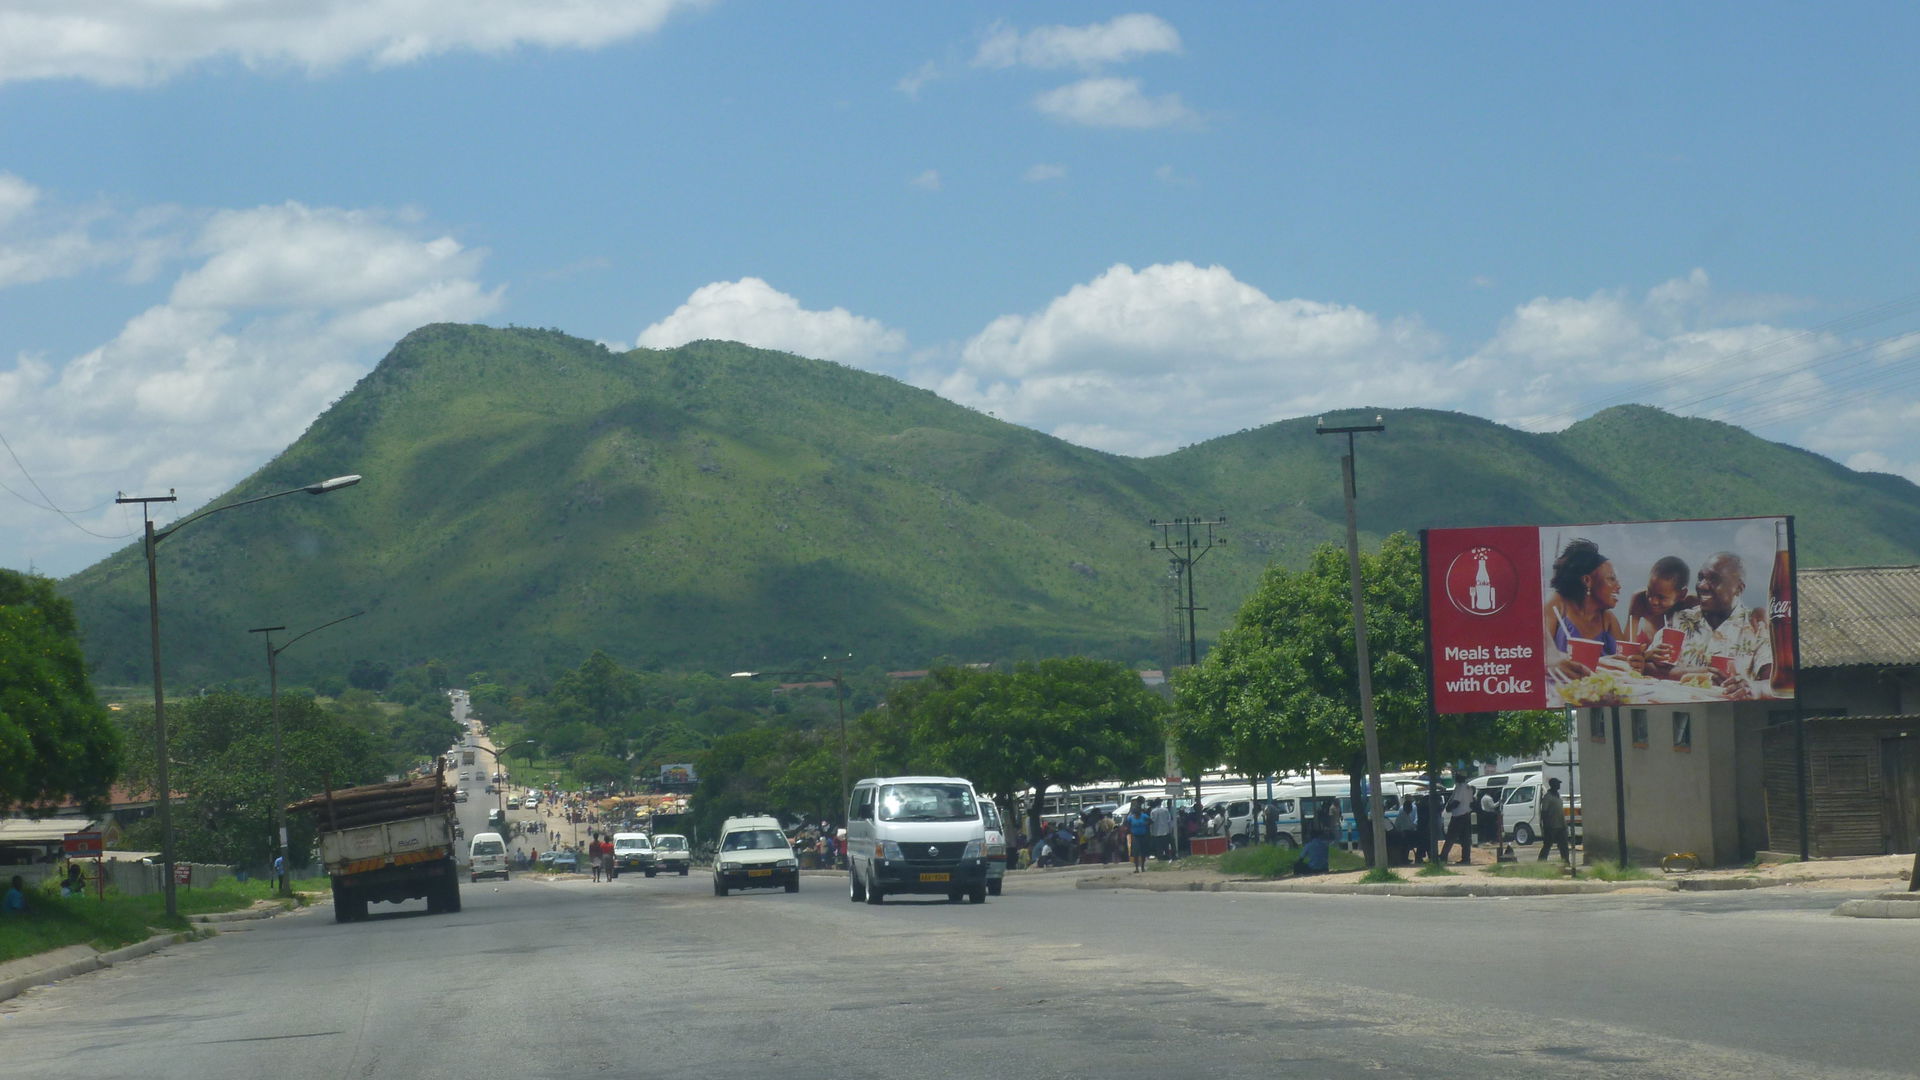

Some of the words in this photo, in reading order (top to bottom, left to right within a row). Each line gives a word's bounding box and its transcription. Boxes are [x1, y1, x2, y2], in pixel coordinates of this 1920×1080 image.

[1445, 645, 1490, 661] Meals
[1494, 645, 1533, 659] taste
[1463, 661, 1512, 676] better
[1445, 677, 1481, 692] with
[1483, 676, 1532, 695] Coke
